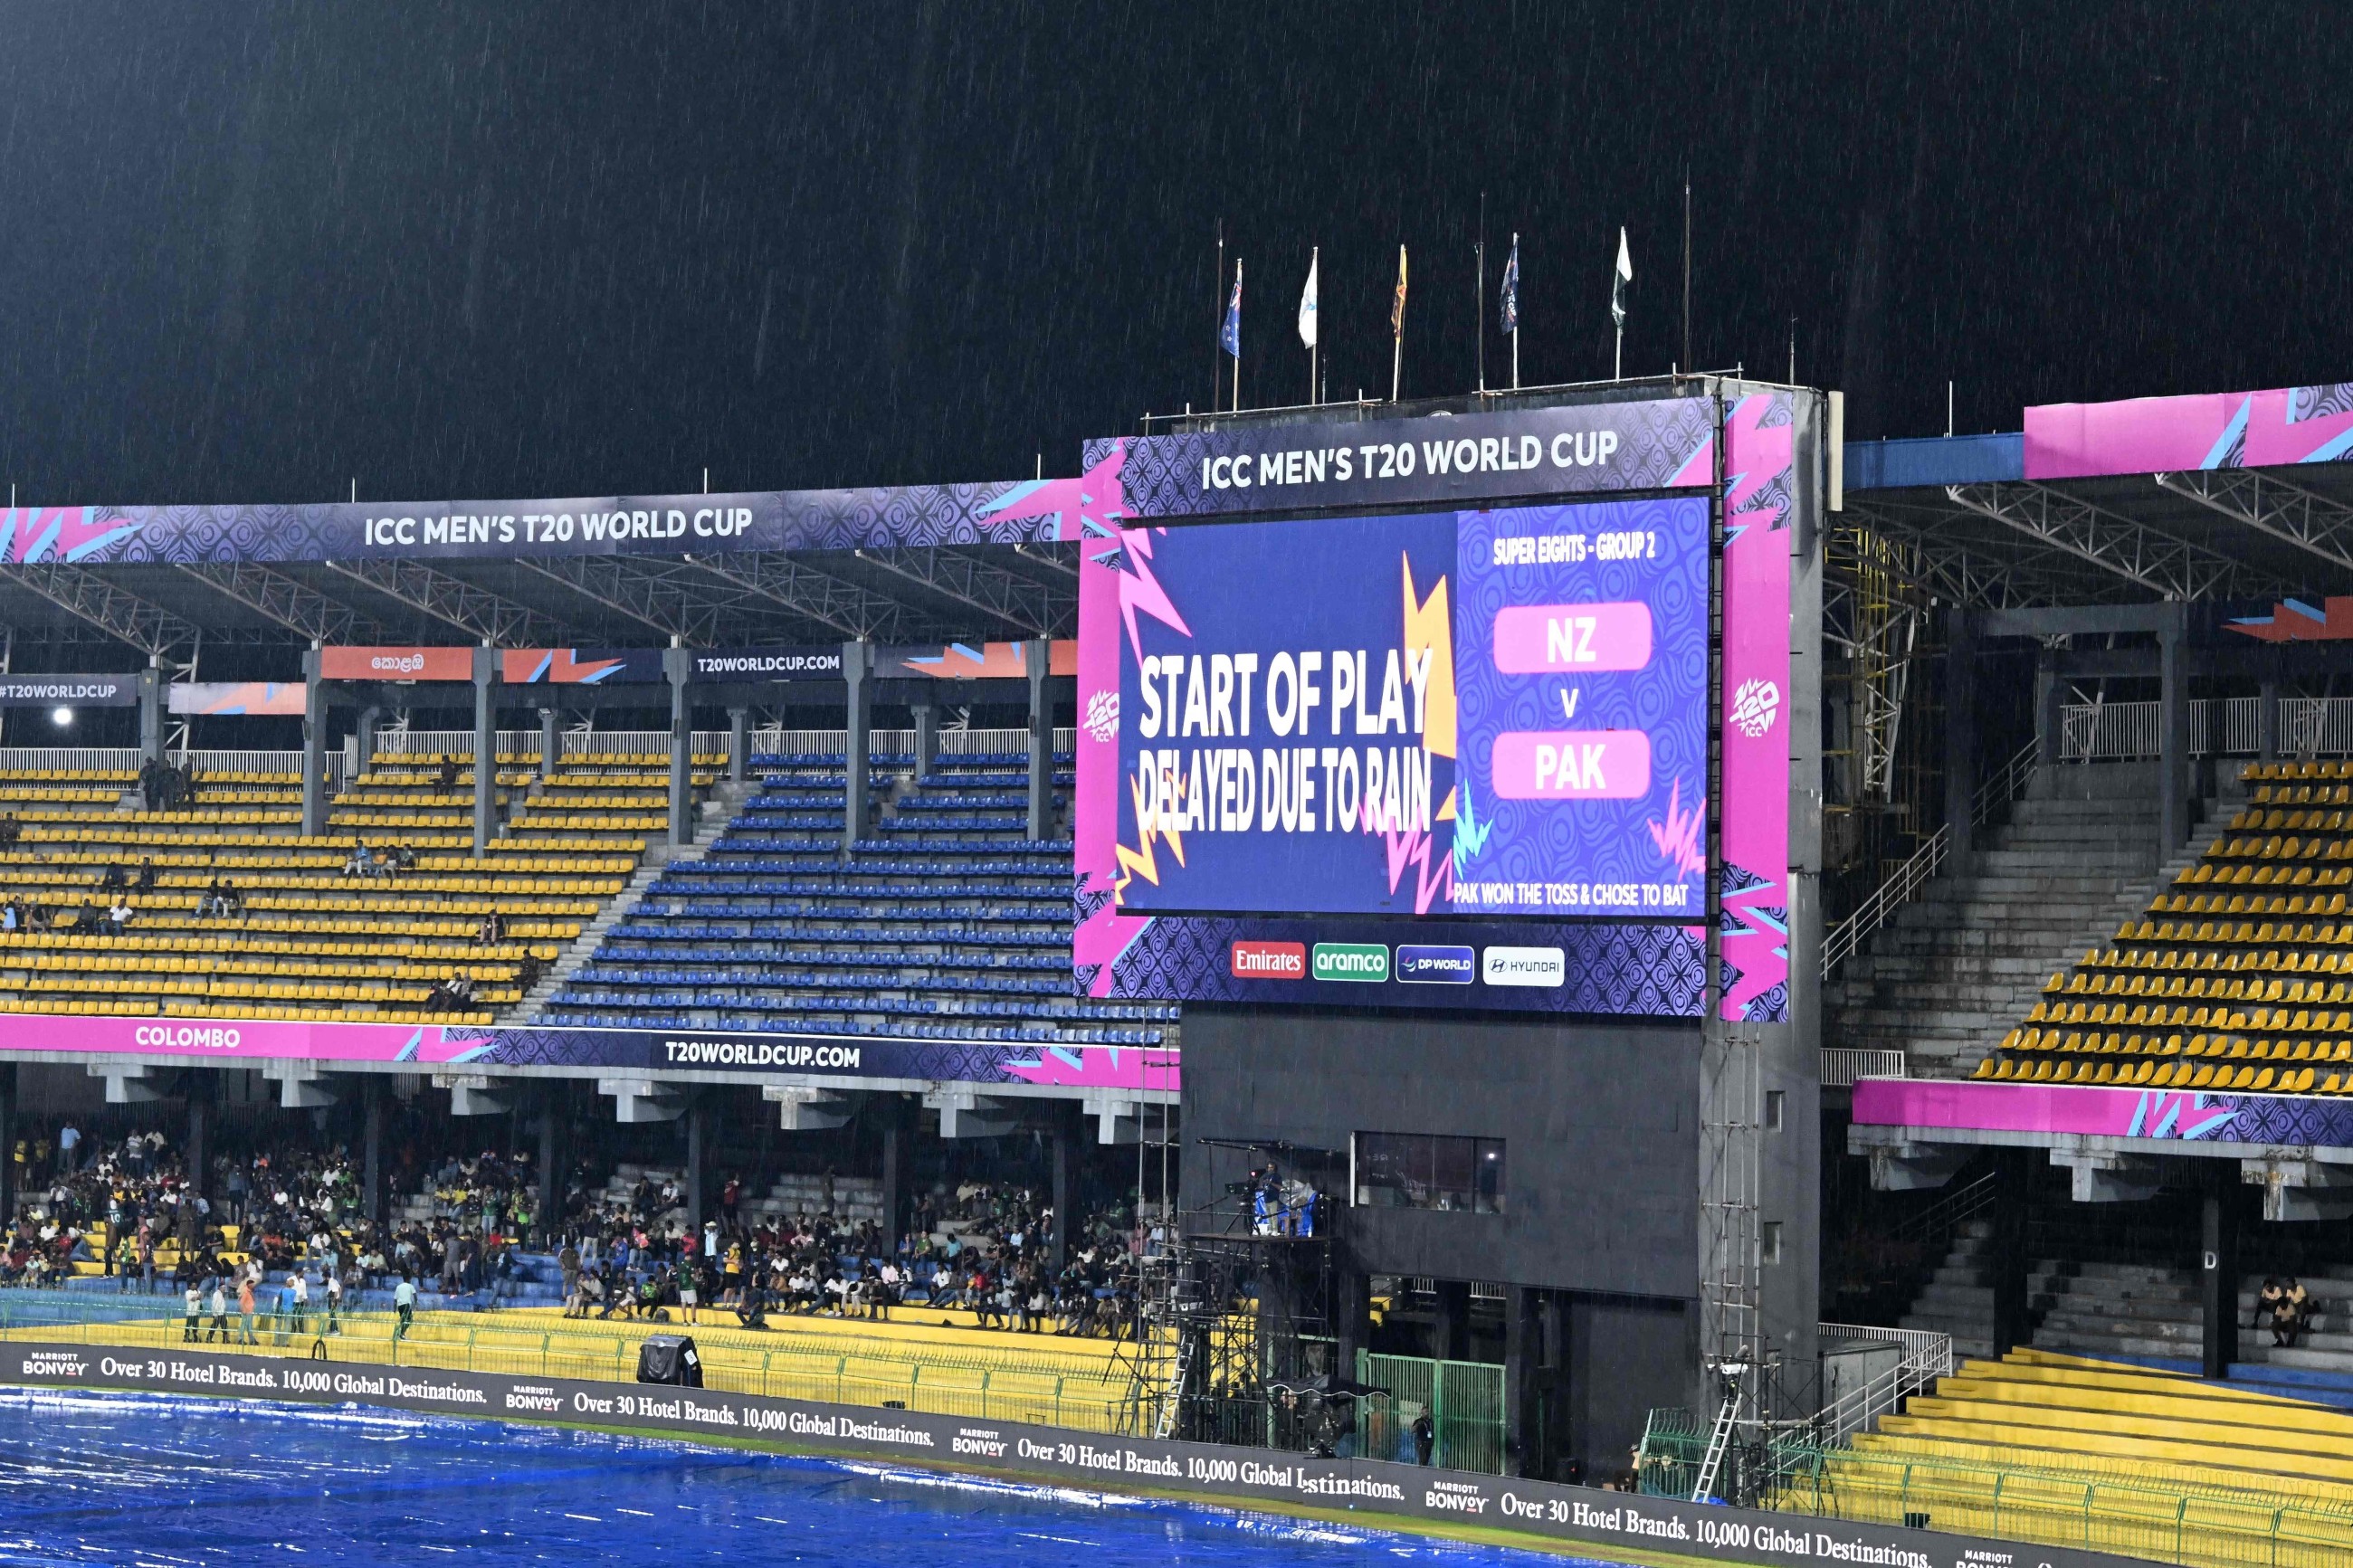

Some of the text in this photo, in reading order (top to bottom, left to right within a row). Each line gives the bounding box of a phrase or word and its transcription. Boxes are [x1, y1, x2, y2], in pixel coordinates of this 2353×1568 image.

[1203, 431, 1618, 489] ICC MEN'S T20 WORLD CUP
[365, 508, 753, 546] ICC MEN'S T20 WORLD CUP
[1493, 535, 1536, 565] SUPER
[1538, 534, 1586, 564] EIGHTS
[1596, 532, 1645, 562] GROUP
[1646, 531, 1656, 558] 2
[1547, 616, 1597, 663] NZ
[697, 655, 840, 672] T20WORLDCUP.COM
[0, 684, 117, 698] #T20WORLDCUP
[1139, 648, 1434, 738] START OF PLAY
[1095, 732, 1110, 743] ICC
[1745, 726, 1763, 737] ICC
[1535, 744, 1606, 790] PAK
[1138, 746, 1432, 833] DELAYED DUE TO RAIN
[1453, 883, 1689, 906] PAK WON THE TOSS & CHOSE TO BAT
[1235, 950, 1301, 972] Emirates
[1316, 953, 1386, 972] aramco
[1418, 958, 1472, 971] DP WORLD
[1510, 961, 1560, 974] HYUNDAI
[135, 1026, 241, 1048] COLOMBO
[665, 1041, 860, 1069] T20WORLDCUP.COM
[2204, 1250, 2217, 1269] D
[32, 1352, 78, 1362] MARRIOTT
[23, 1361, 86, 1376] BONVOY
[100, 1356, 488, 1404] Over 30 Hotel Brands. 10,000 Global Destinations.
[513, 1385, 554, 1395] MARRIOTT
[506, 1394, 561, 1411] BONVOY
[574, 1392, 935, 1447] Over 30 Hotel Brands. 10,000 Global Destinations.
[959, 1428, 999, 1440] MARRIOTT
[952, 1437, 1005, 1458] BONVOY
[1017, 1438, 1405, 1501] Over 30 Hotel Brands. 10,000 Global stinations.
[1434, 1481, 1479, 1494] MARRIOTT
[1425, 1491, 1486, 1514] BONVOY
[1500, 1492, 1544, 1520] Over
[1548, 1499, 1569, 1524] 30
[1572, 1502, 1621, 1531] Hotel
[1624, 1509, 1691, 1541] Brands.
[1696, 1519, 1750, 1549] 10,000
[1753, 1525, 1811, 1555] Global
[1965, 1549, 2014, 1564] MARRIOTT
